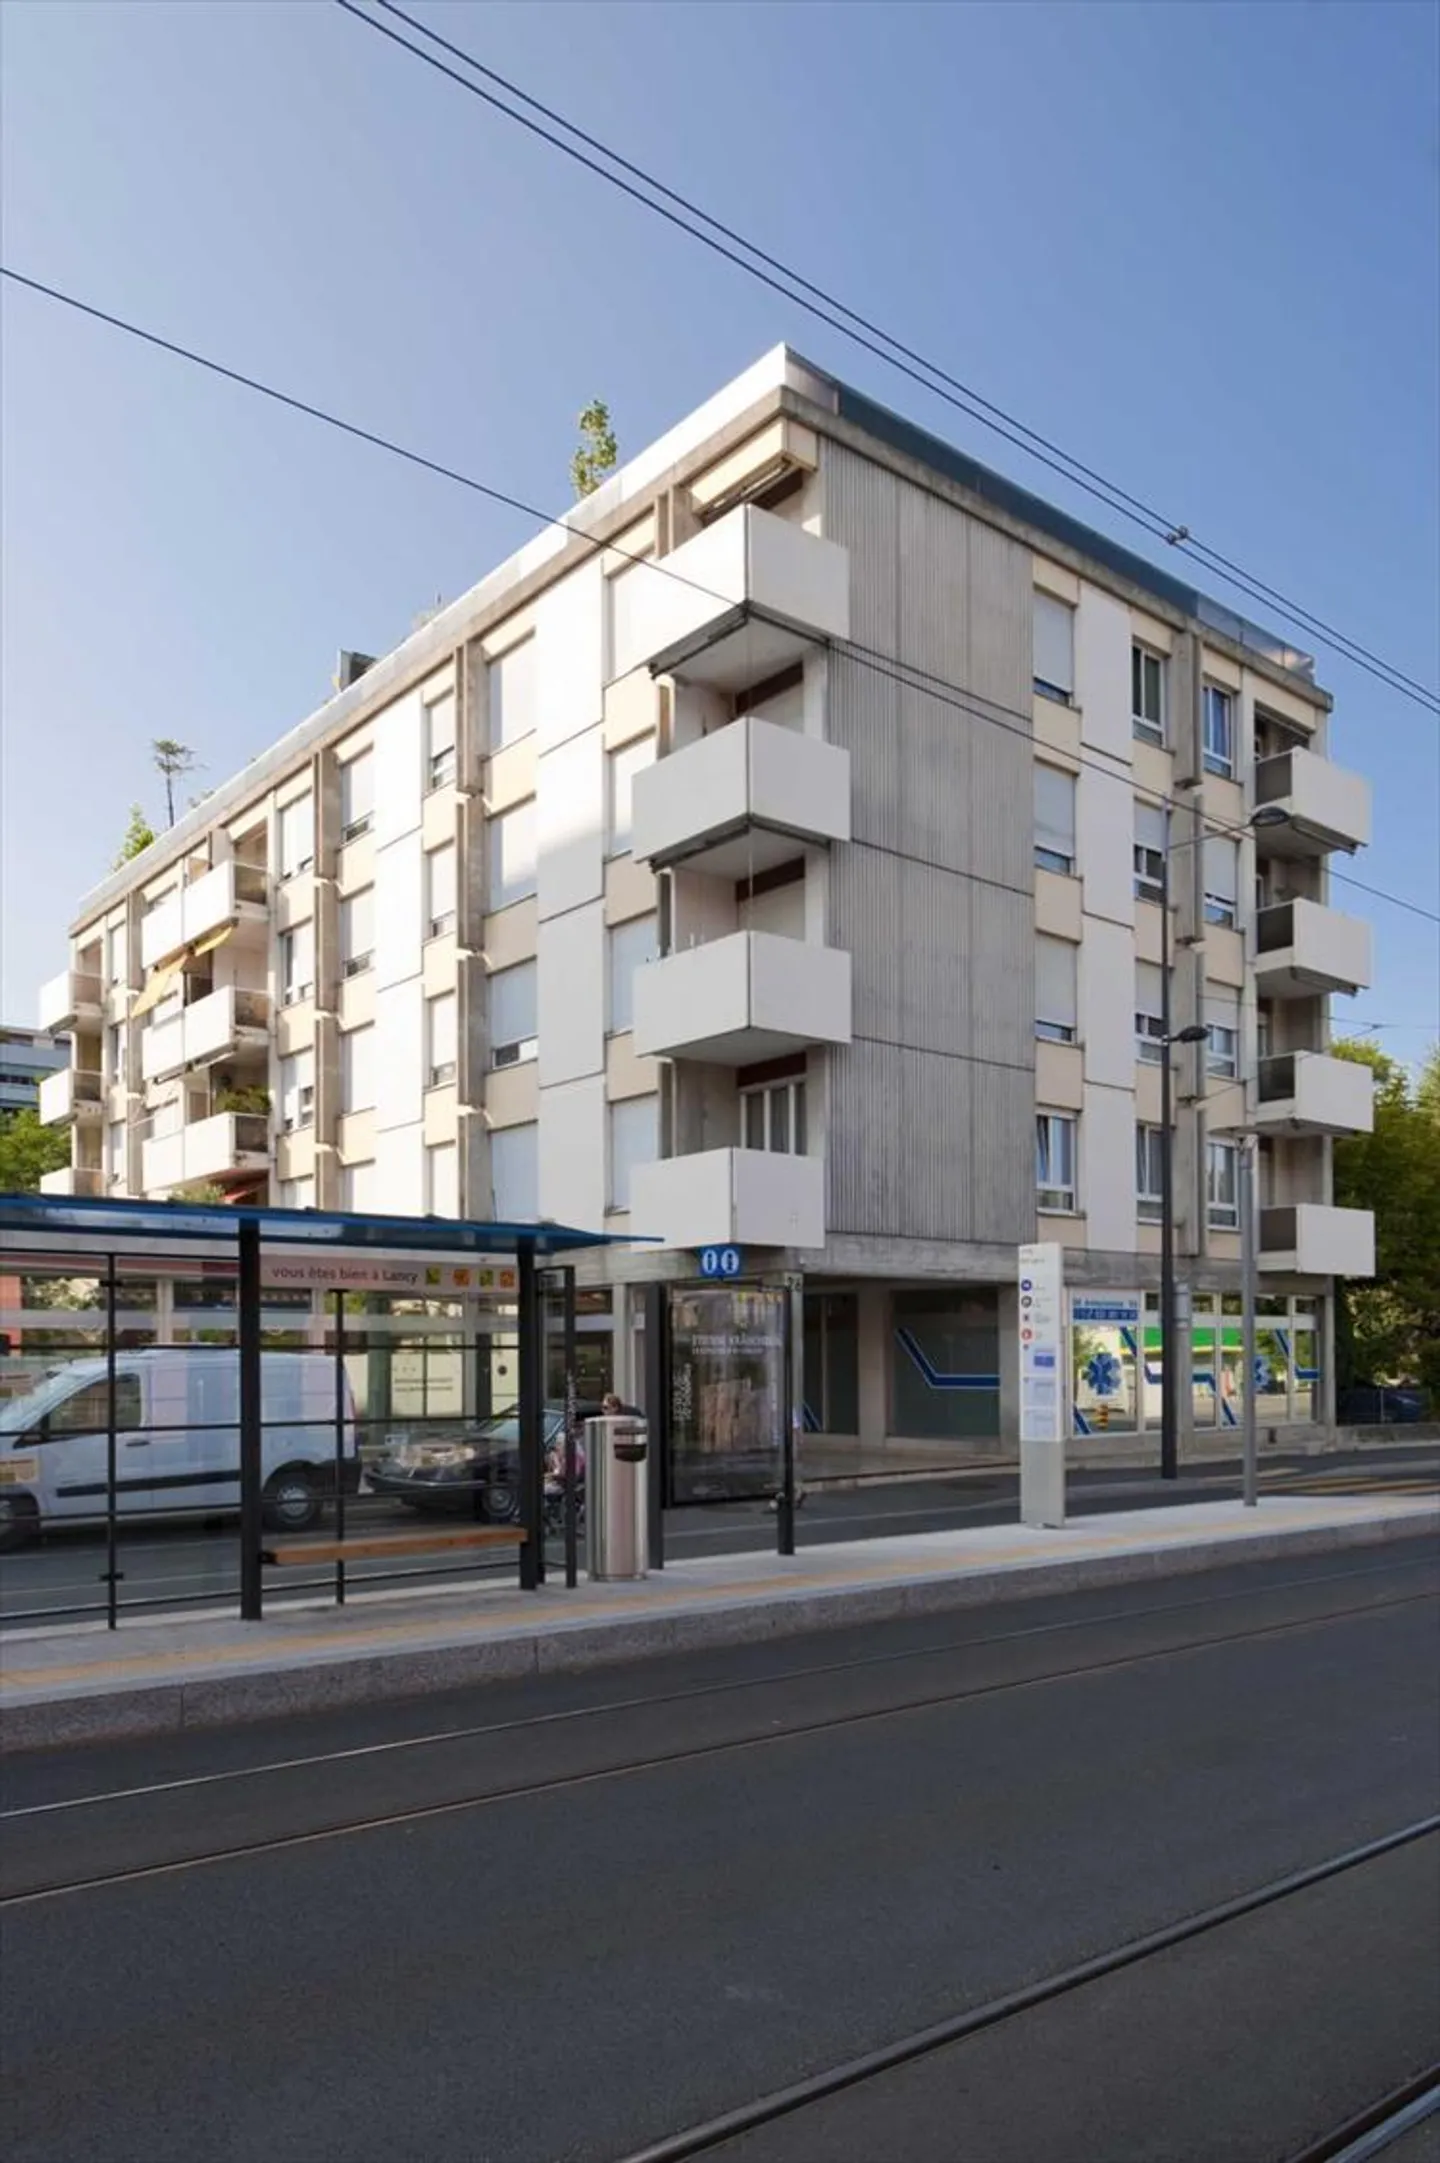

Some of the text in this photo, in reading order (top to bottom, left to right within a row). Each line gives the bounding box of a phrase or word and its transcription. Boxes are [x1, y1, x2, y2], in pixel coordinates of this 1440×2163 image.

[272, 1267, 304, 1278] vous
[340, 1265, 367, 1279] bien
[382, 1269, 418, 1286] Lancy
